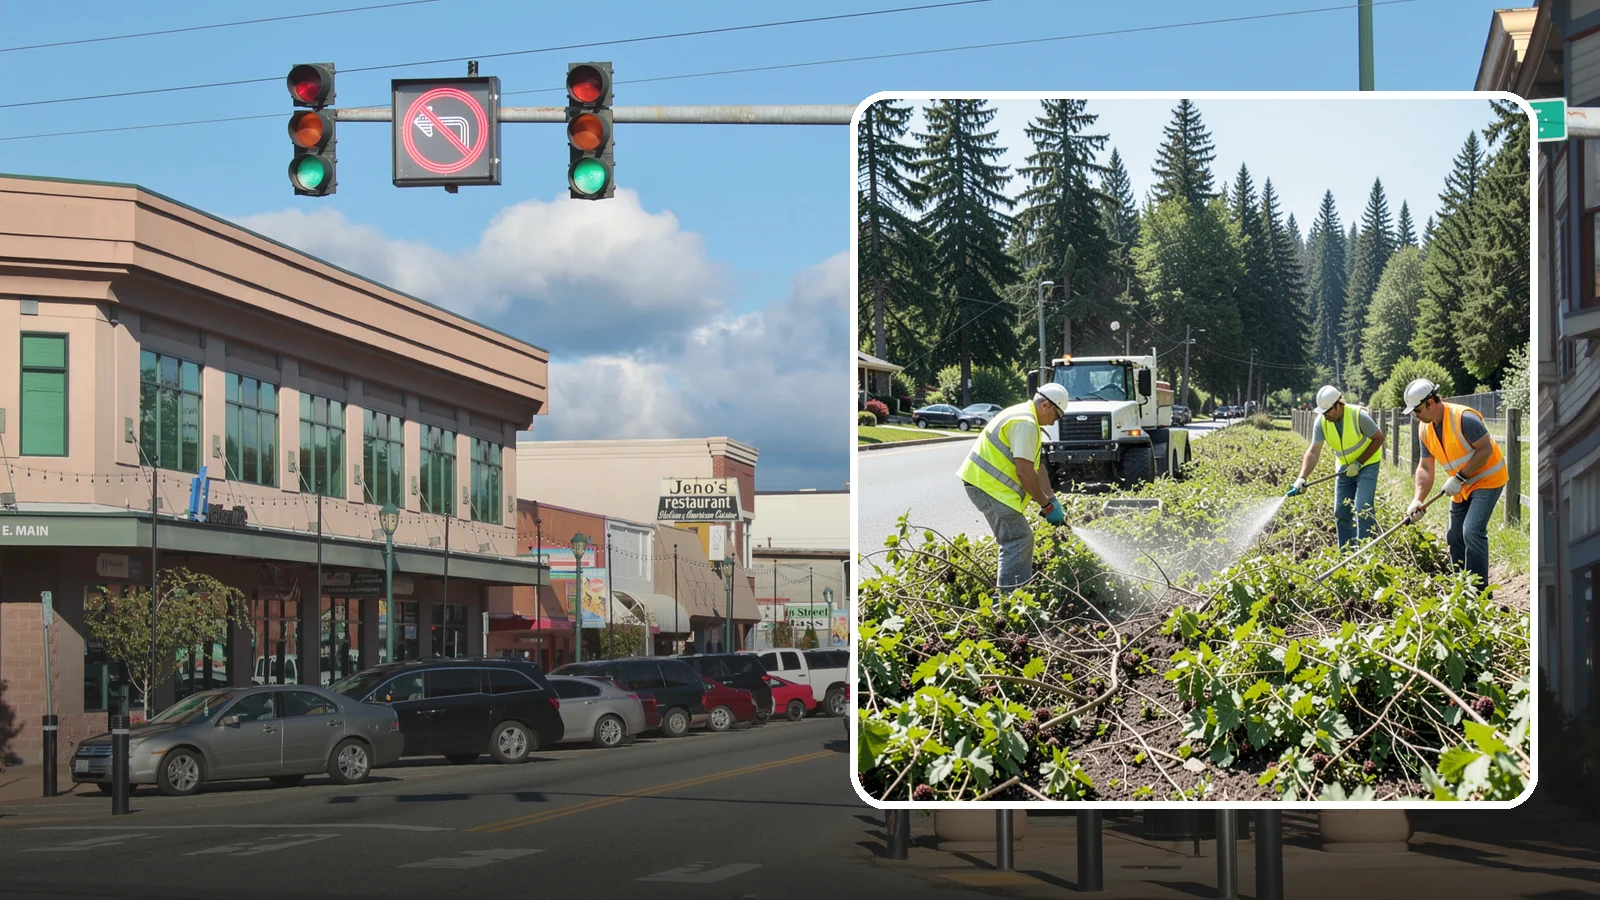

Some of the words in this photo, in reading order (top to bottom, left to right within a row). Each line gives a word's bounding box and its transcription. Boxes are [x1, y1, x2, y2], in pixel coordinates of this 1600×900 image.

[670, 480, 727, 494] Jeno's
[665, 496, 731, 509] restaurant
[659, 510, 682, 519] Italian
[686, 510, 714, 519] American
[715, 510, 737, 519] Cuisine
[2, 525, 13, 536] E.
[16, 525, 49, 536] MAIN
[797, 607, 828, 617] Street
[791, 619, 824, 627] lass
